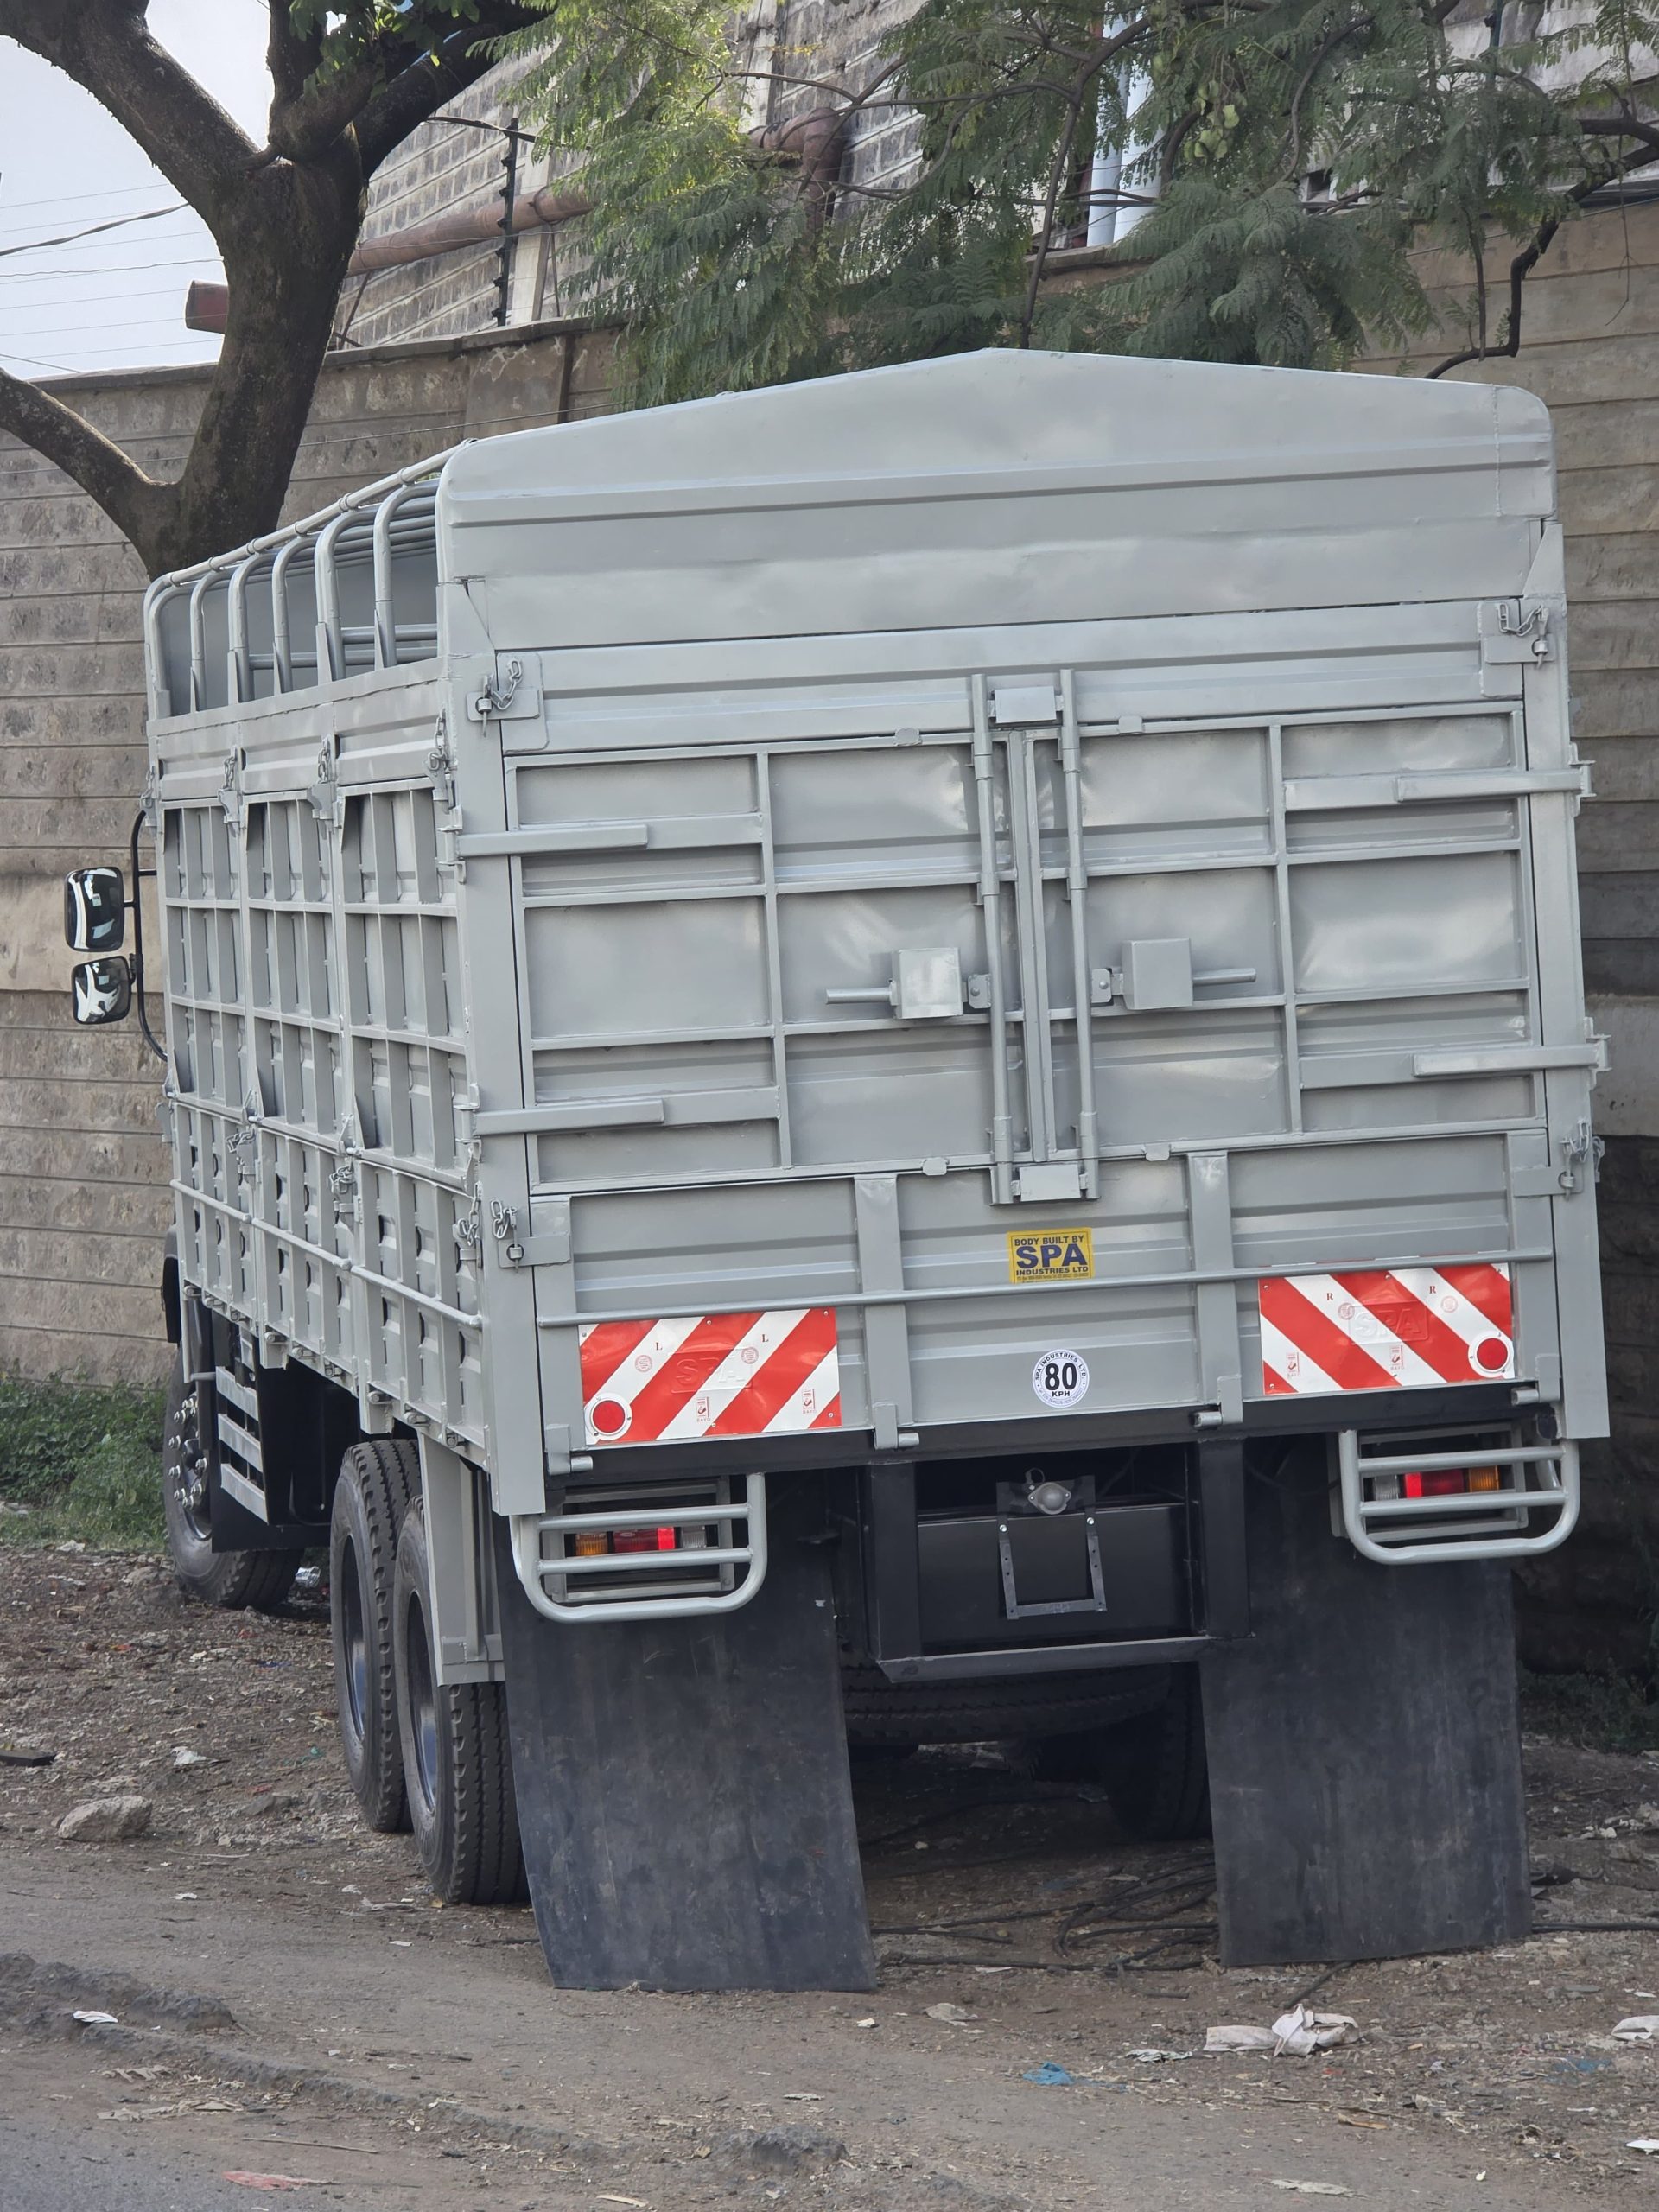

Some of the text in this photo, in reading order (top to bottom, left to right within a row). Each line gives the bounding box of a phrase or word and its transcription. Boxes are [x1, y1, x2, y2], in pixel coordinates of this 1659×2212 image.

[1042, 1236, 1069, 1244] BUILT
[1016, 1243, 1088, 1269] SPA
[1015, 1267, 1071, 1276] INDUSTRIES
[1429, 1285, 1436, 1294] R
[1354, 1307, 1421, 1338] SPA
[762, 1334, 769, 1343] L
[656, 1342, 663, 1351] L
[1040, 1352, 1078, 1367] INDUSTRIES
[1045, 1362, 1077, 1391] 80
